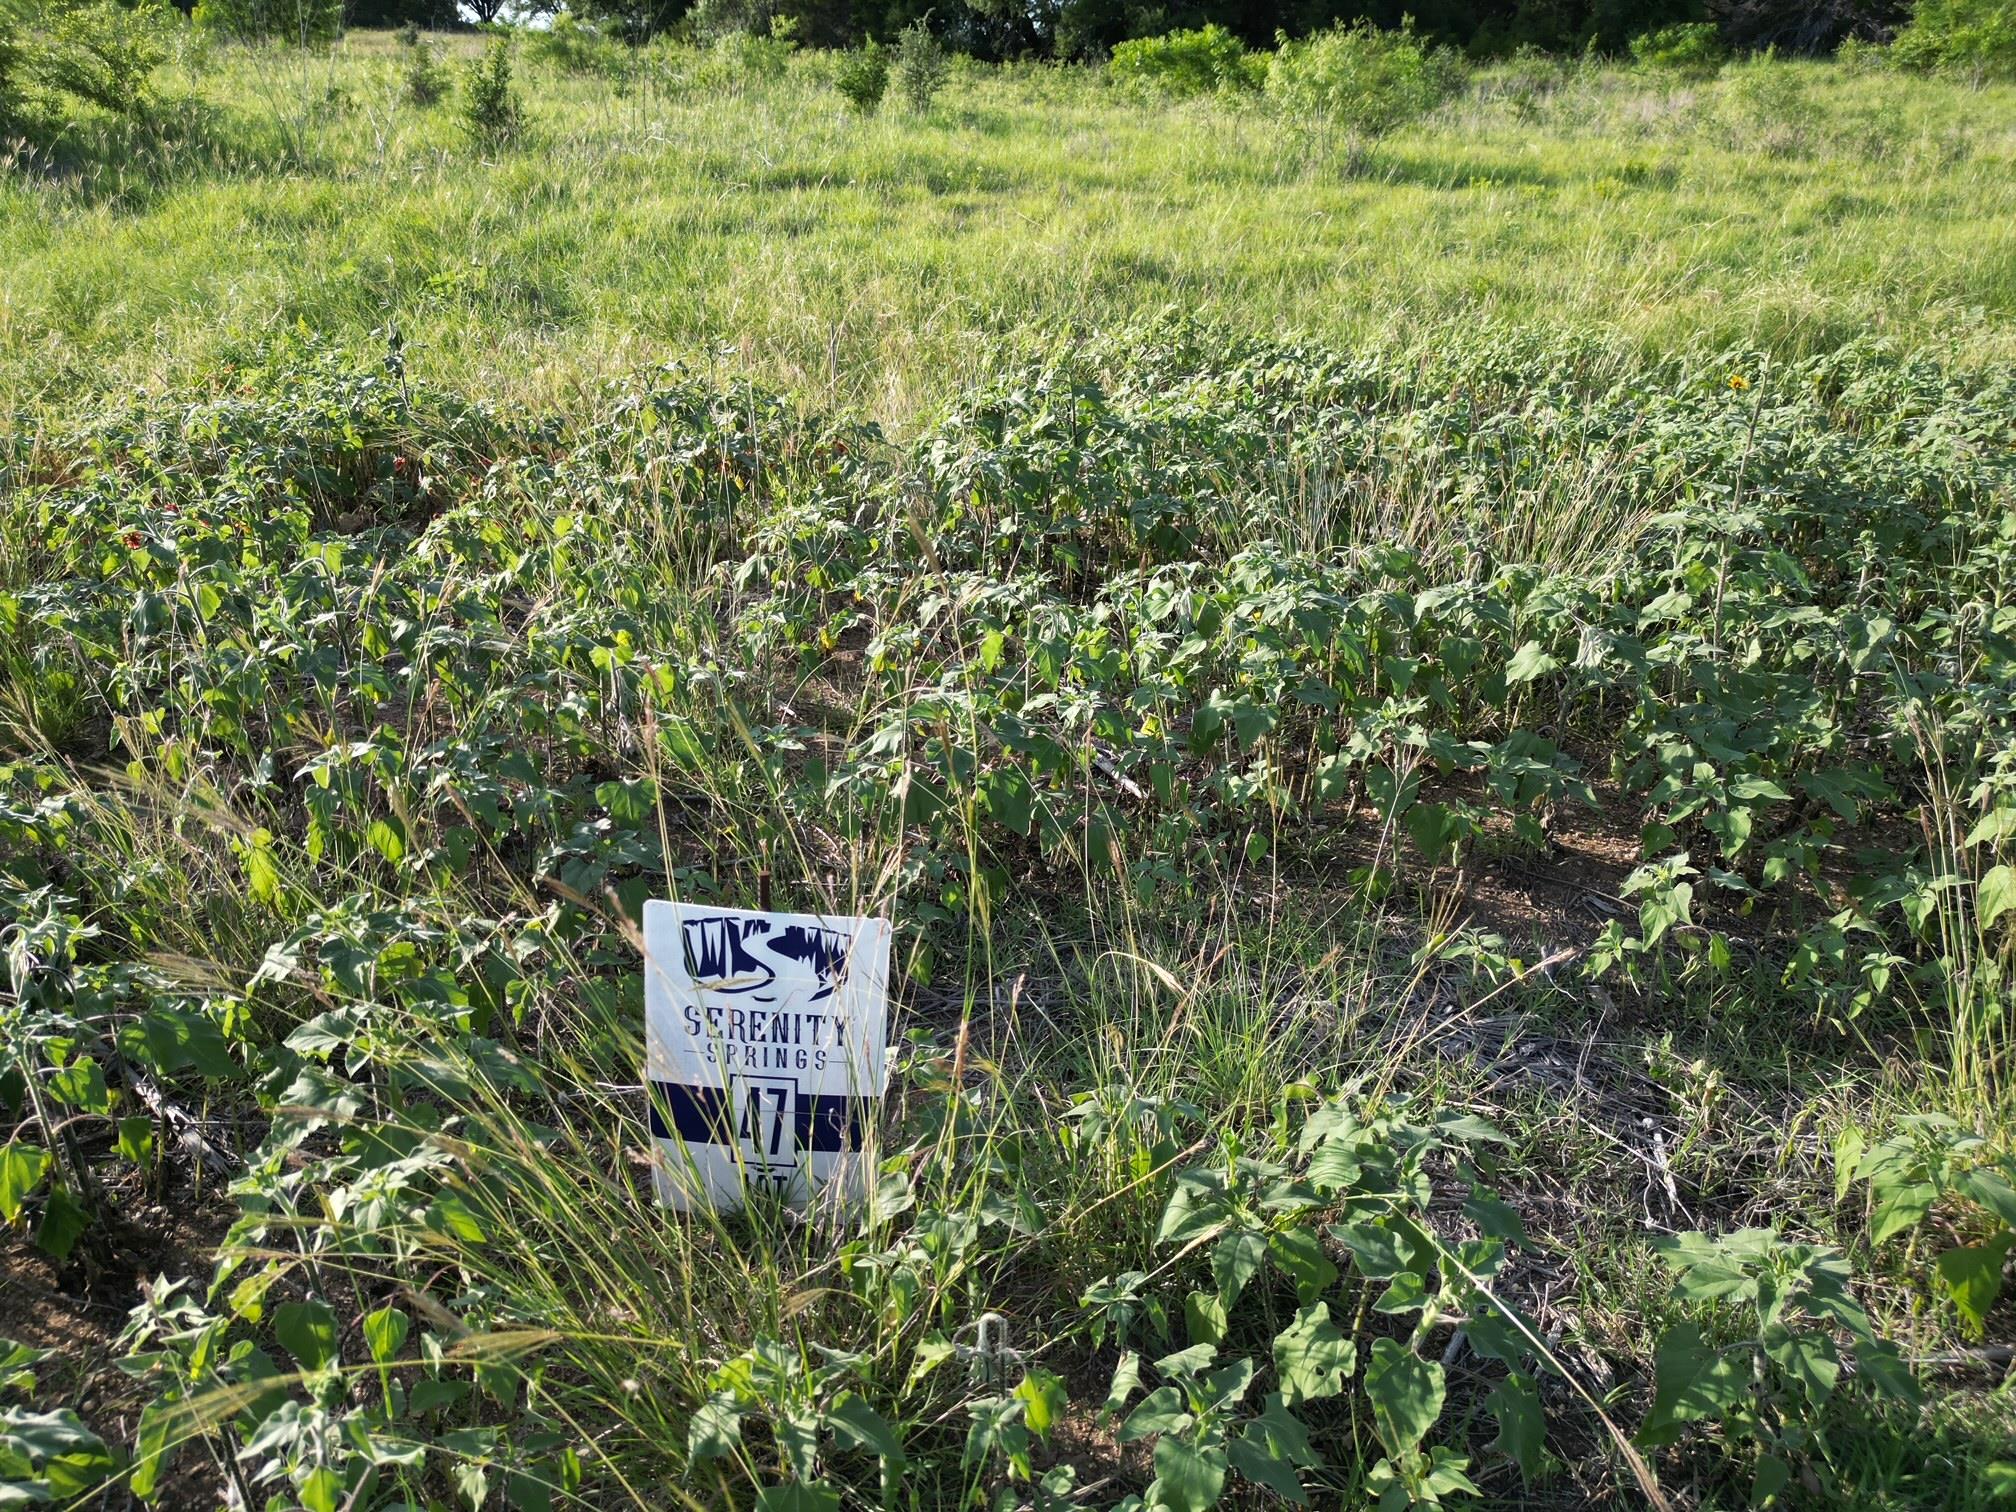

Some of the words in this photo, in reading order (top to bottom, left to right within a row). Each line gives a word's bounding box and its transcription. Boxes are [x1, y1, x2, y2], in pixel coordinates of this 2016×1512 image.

[684, 1005, 855, 1046] SERENITY
[707, 1042, 827, 1071] SPRINGS
[740, 1086, 788, 1155] 47
